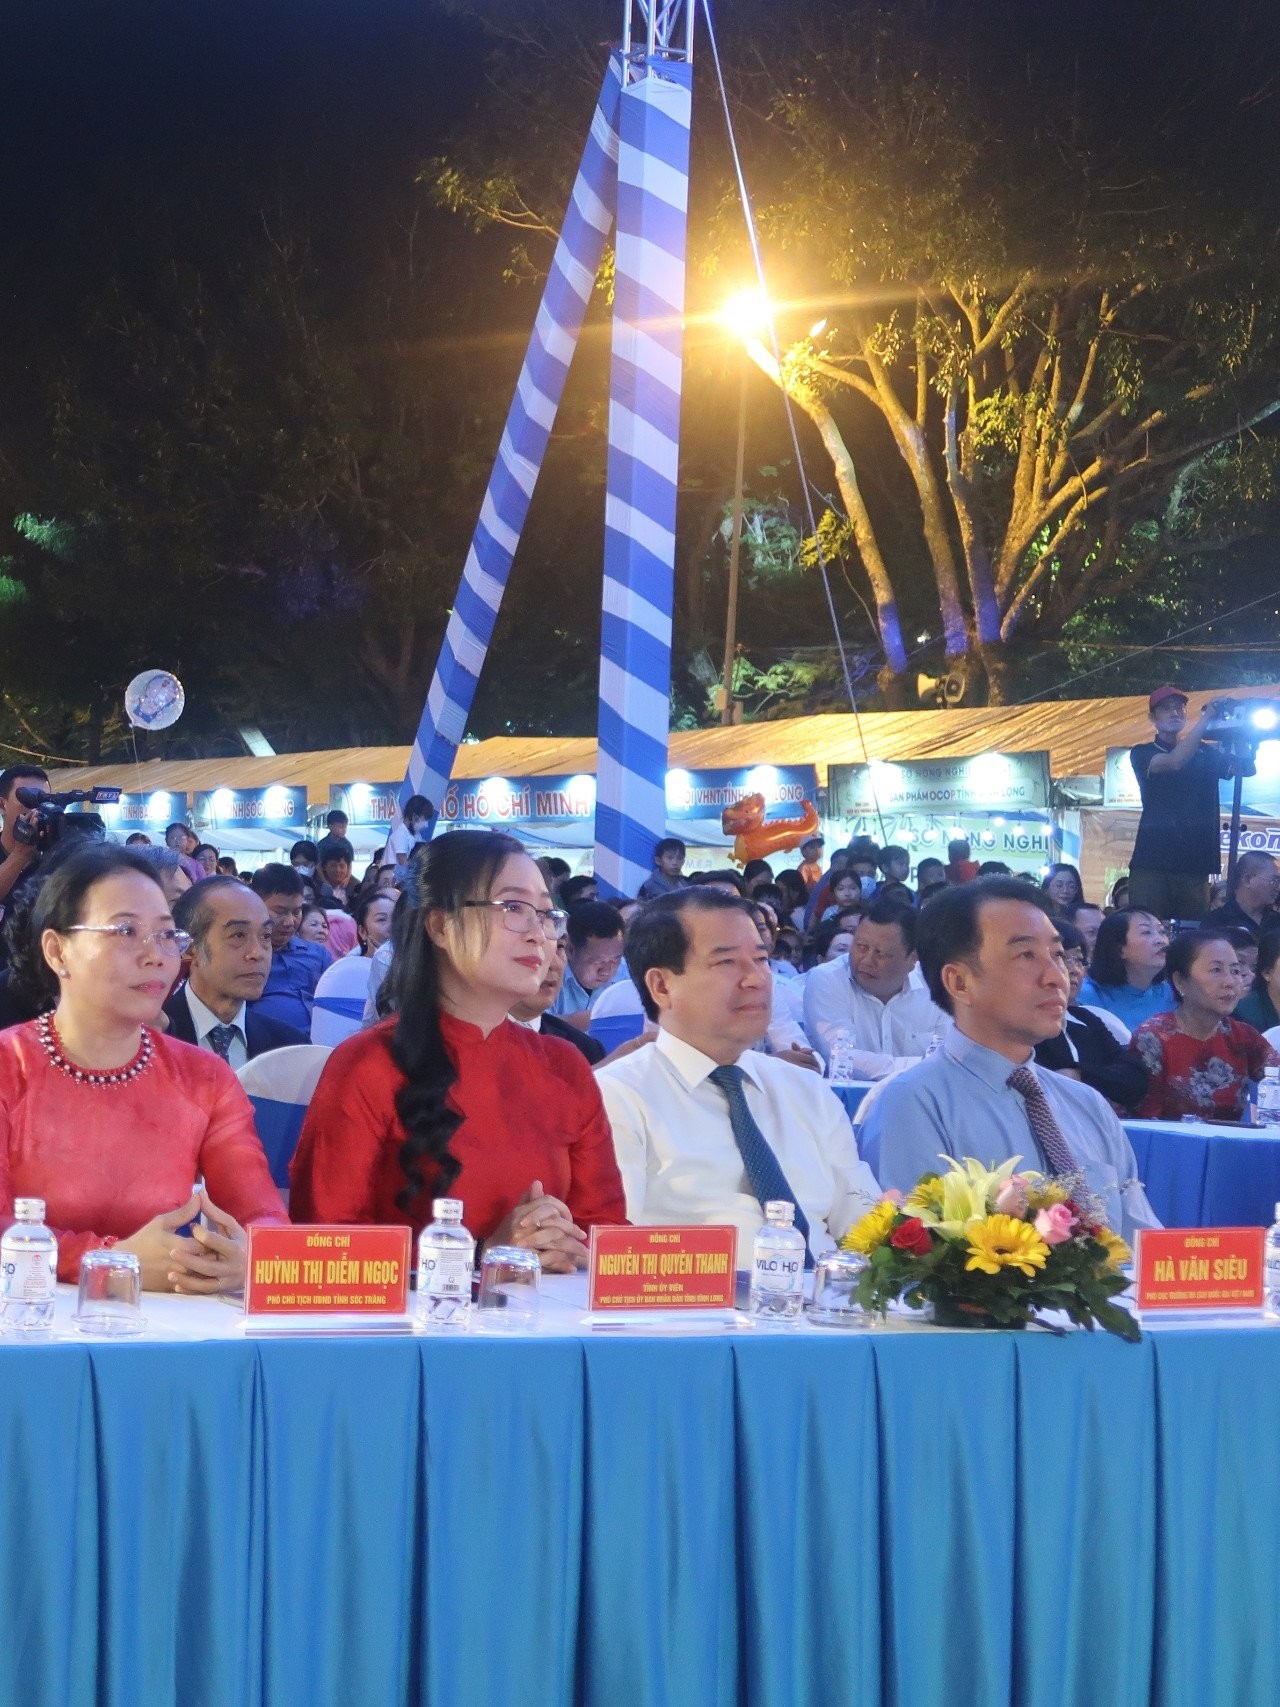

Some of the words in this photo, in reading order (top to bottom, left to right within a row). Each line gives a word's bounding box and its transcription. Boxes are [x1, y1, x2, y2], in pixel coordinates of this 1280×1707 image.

[495, 787, 531, 818] CHÍ
[535, 790, 591, 817] MINH
[306, 1233, 333, 1248] ĐỒNG
[335, 1234, 351, 1248] CHÍ
[255, 1255, 300, 1285] HUỲNH
[303, 1260, 323, 1290] THỊ
[326, 1252, 360, 1285] DIỄM
[363, 1260, 399, 1290] NGỌC
[599, 1246, 640, 1276] NGUYỄN
[642, 1253, 658, 1280] THỊ
[695, 1253, 729, 1275] THANH
[1154, 1255, 1175, 1282] HÀ
[1178, 1255, 1209, 1281] VĂN
[1213, 1254, 1248, 1281] SIÊU
